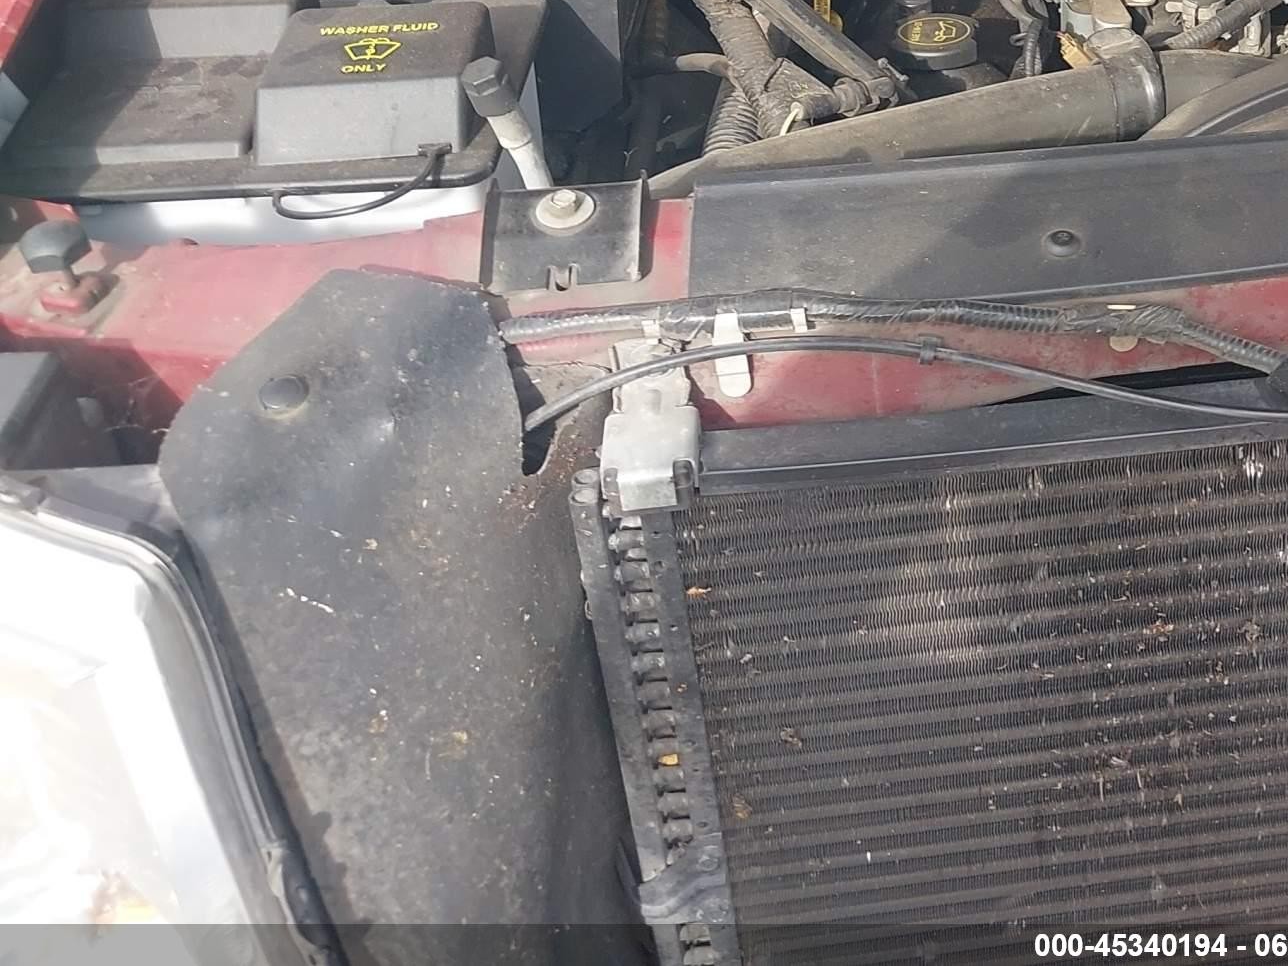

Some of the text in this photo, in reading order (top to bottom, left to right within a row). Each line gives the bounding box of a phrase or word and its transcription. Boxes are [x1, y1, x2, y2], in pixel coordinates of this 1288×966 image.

[319, 22, 440, 36] WASHER FLUID
[340, 63, 387, 74] ONLY
